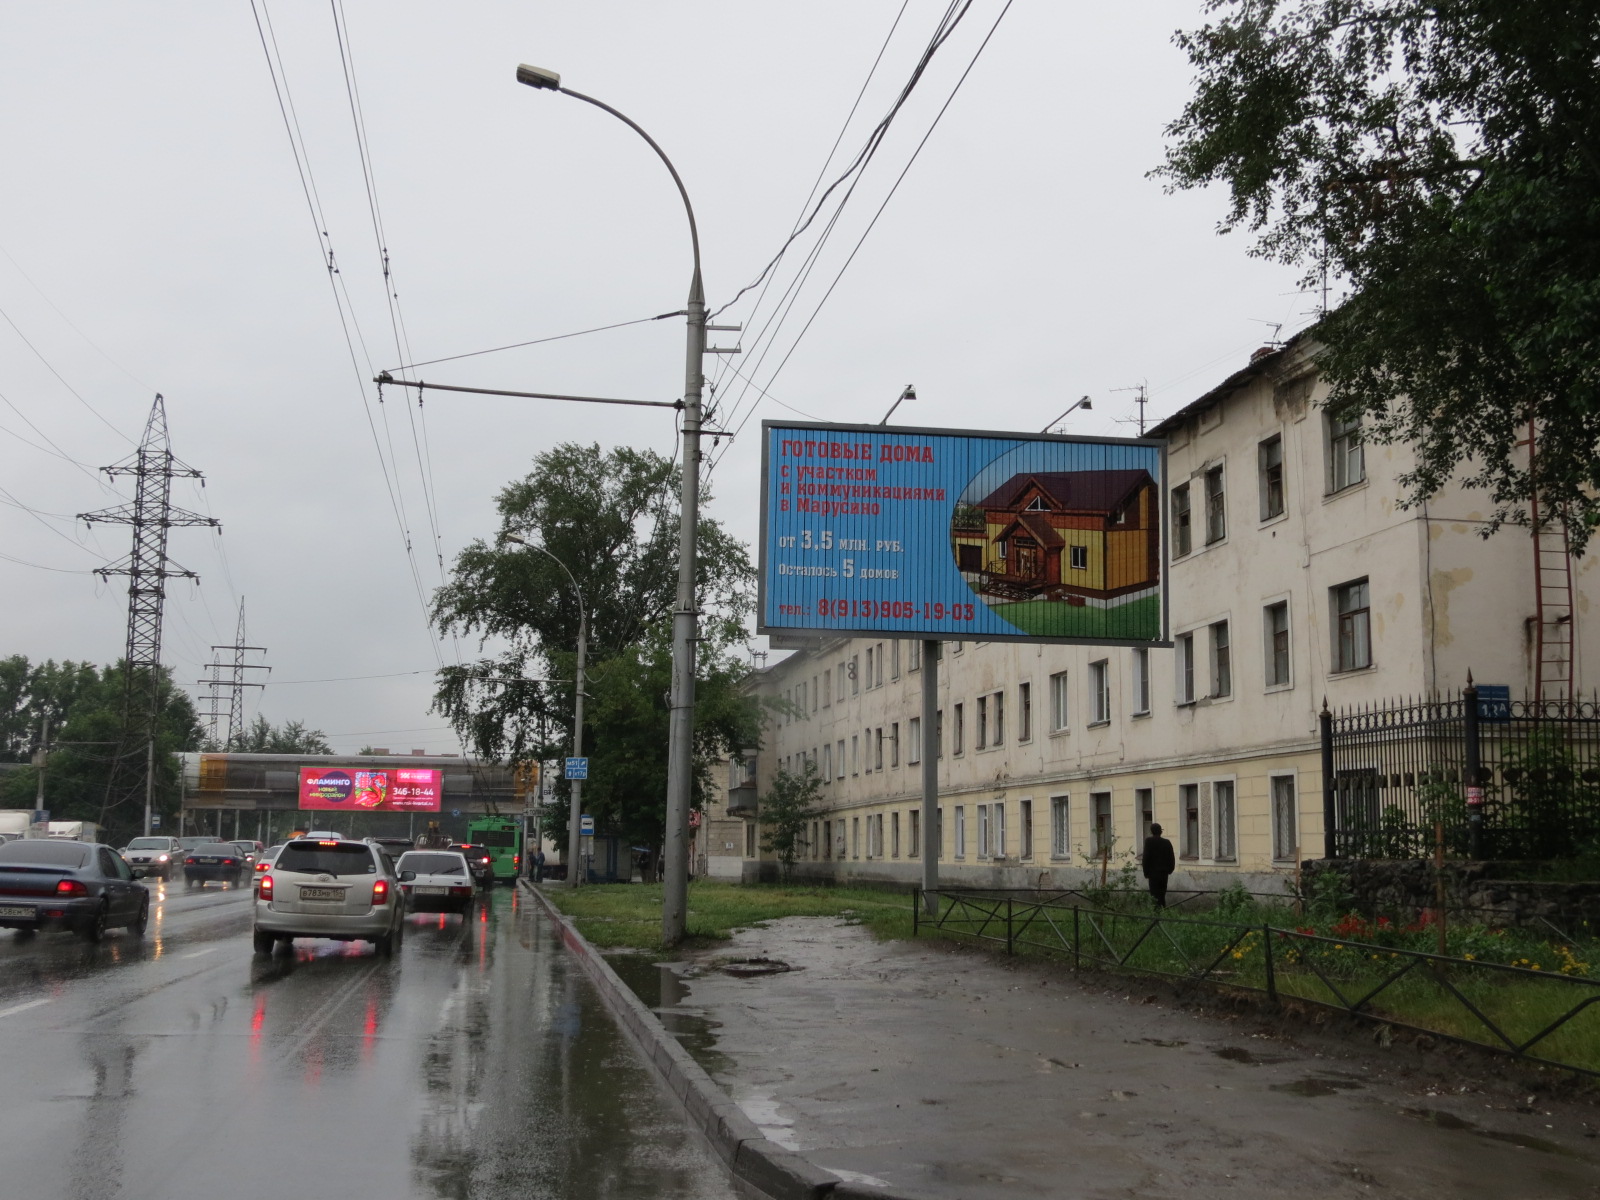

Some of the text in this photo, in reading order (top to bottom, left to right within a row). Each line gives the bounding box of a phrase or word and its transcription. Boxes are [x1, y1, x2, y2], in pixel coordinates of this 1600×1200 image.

[781, 439, 934, 464] ГОТОВЫЕ ДОМА
[780, 464, 877, 483] с участком
[780, 482, 945, 501] и коммуникациями
[780, 497, 880, 517] в Марусино
[801, 530, 833, 551] 3,5
[778, 563, 838, 577] Осталось
[842, 558, 855, 578] 5
[818, 599, 975, 621] 8(913)905-19-03
[306, 778, 351, 786] ФЛАМИНГО
[392, 787, 434, 796] 346-18-44
